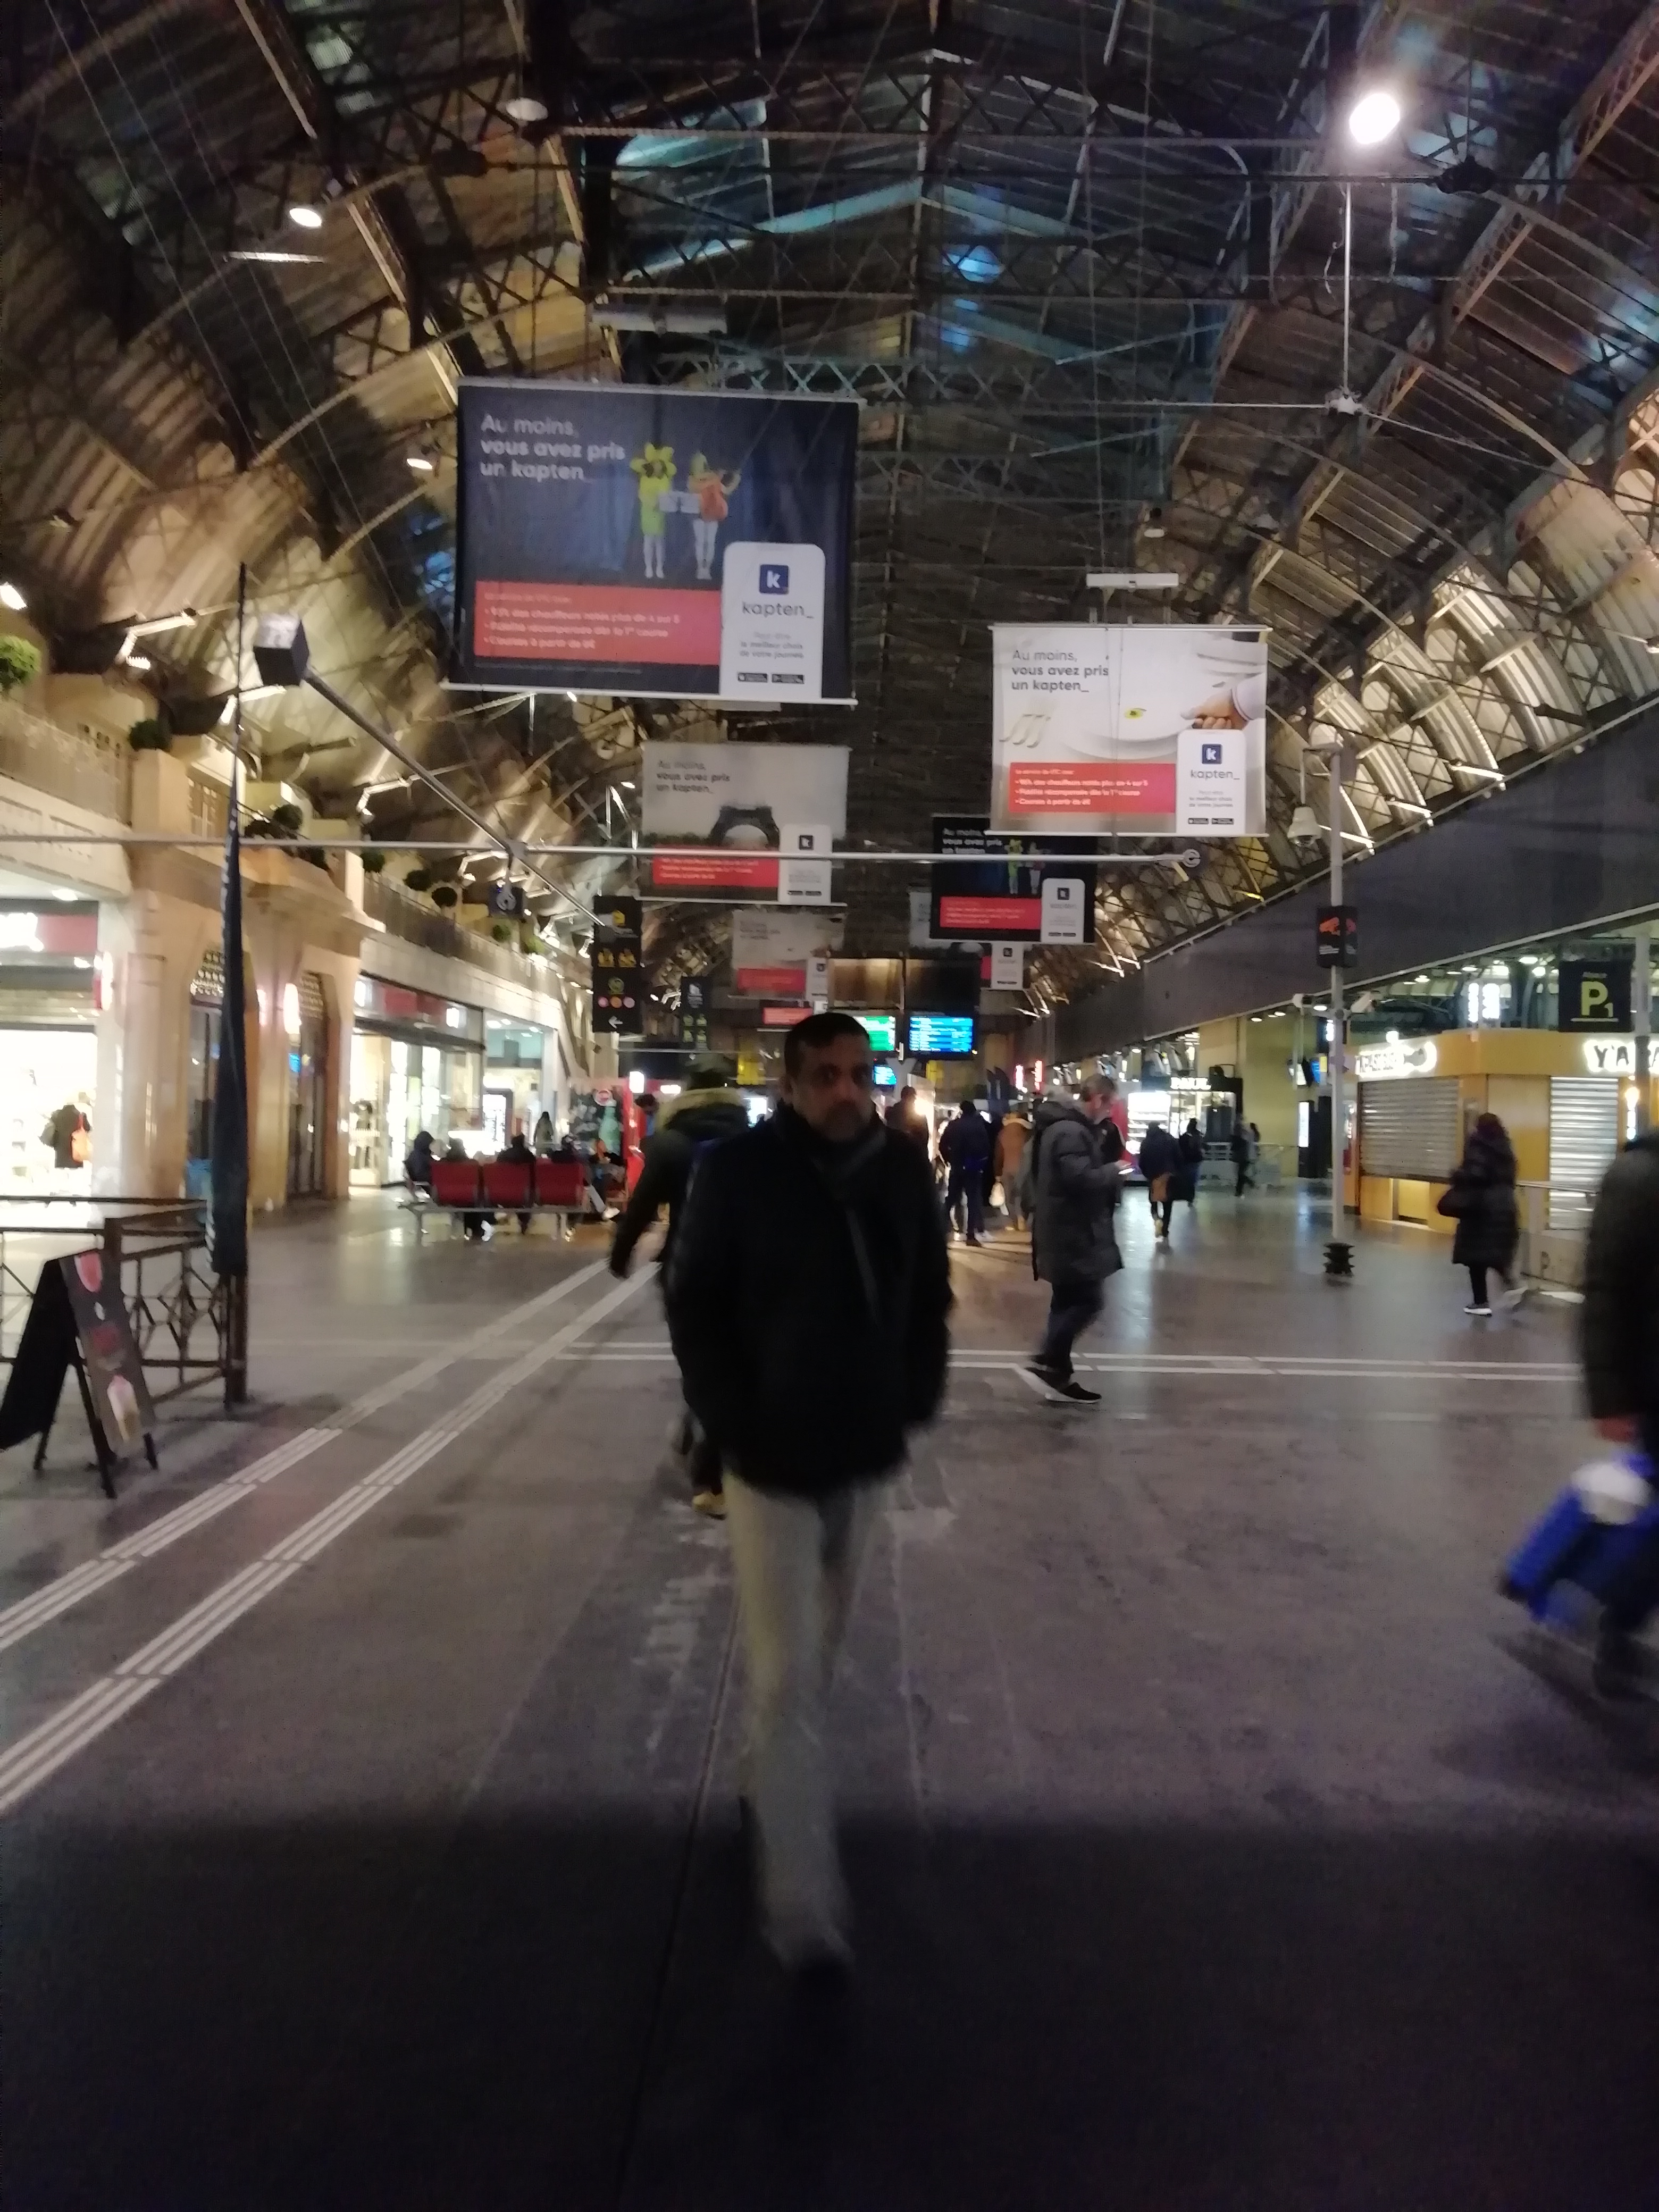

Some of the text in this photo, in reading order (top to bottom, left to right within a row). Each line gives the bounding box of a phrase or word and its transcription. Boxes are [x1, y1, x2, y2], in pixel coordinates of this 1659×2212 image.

[481, 414, 506, 433] Au
[481, 440, 625, 463] vous avez pris
[481, 462, 505, 476] un
[1013, 650, 1077, 662] Au moins,
[1012, 665, 1109, 678] vous avez pris
[711, 773, 730, 783] pris
